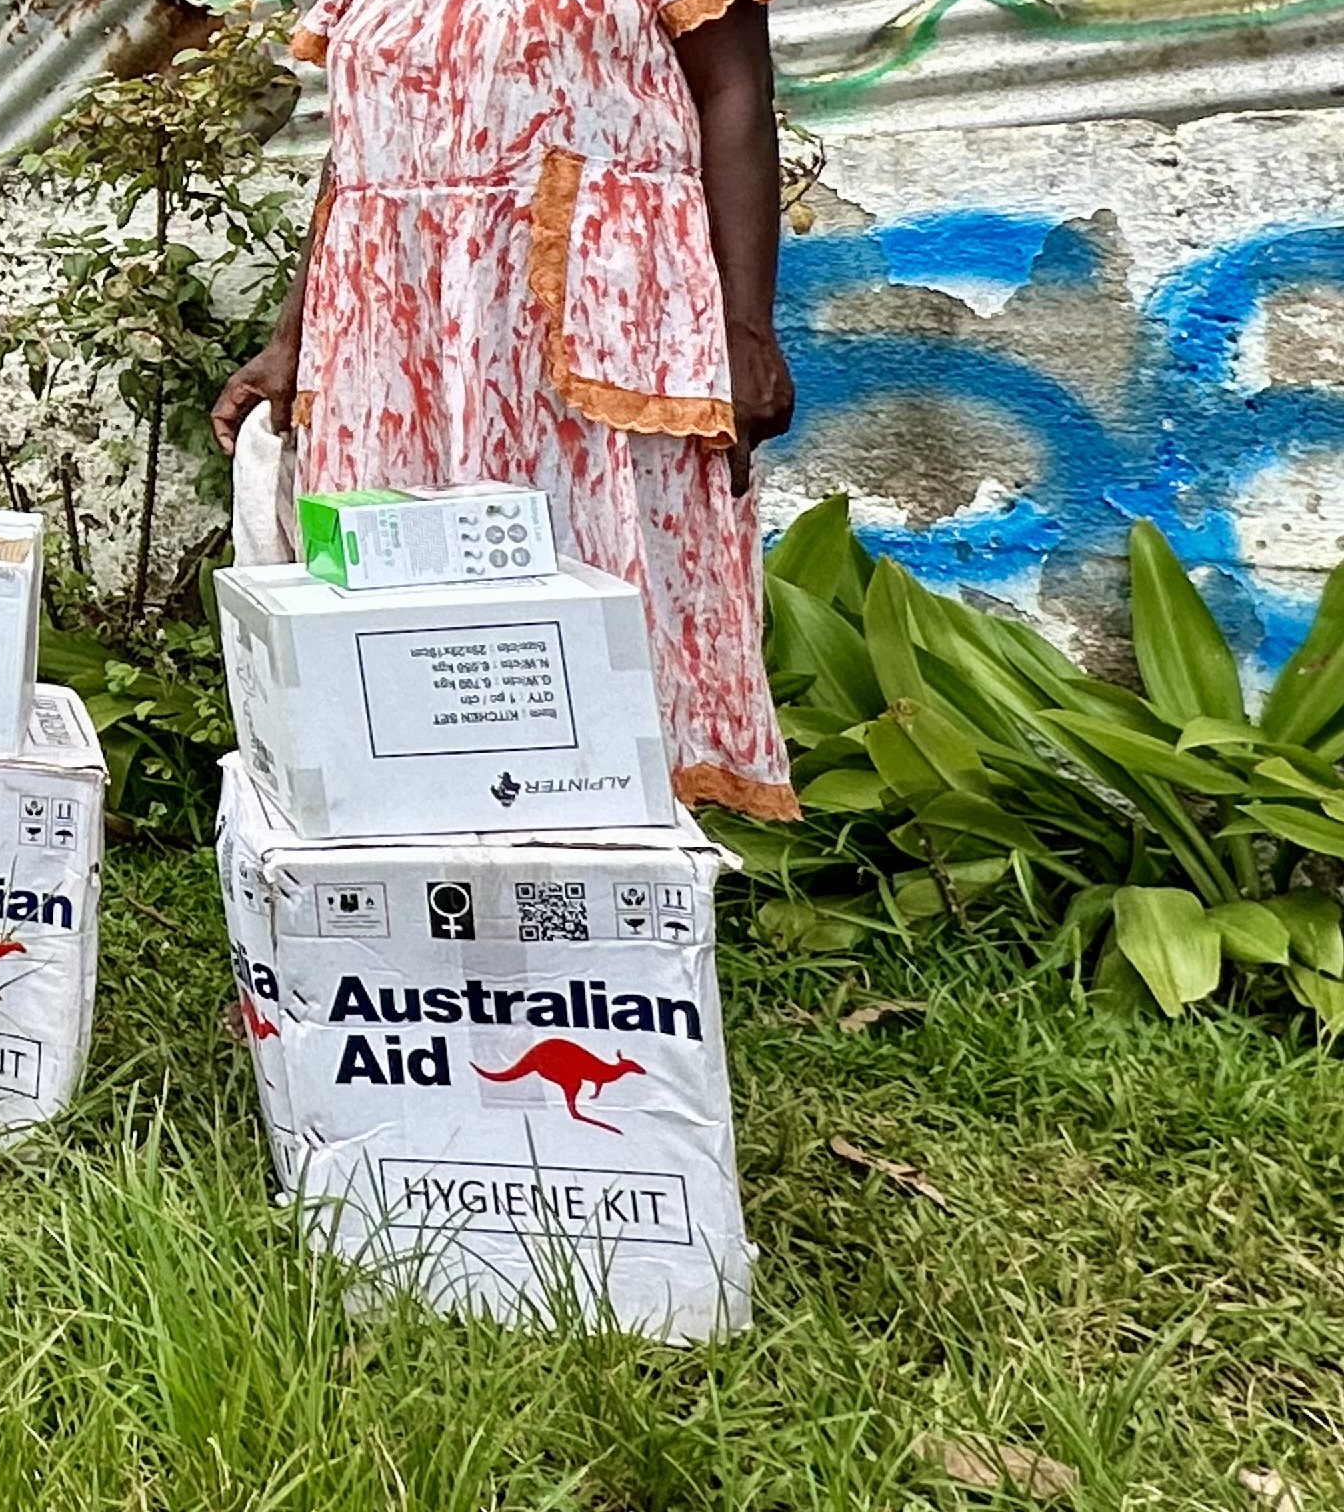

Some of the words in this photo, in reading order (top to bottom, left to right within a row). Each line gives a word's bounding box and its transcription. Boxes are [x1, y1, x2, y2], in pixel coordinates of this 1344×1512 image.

[527, 691, 554, 703] QTY
[433, 711, 458, 726] SET
[461, 709, 519, 724] KITCHEN
[523, 774, 632, 795] ALPINTER
[328, 974, 704, 1043] Australian
[334, 1034, 452, 1087] Aid
[402, 1175, 588, 1221] HYGIENE
[603, 1188, 668, 1227] KIT
